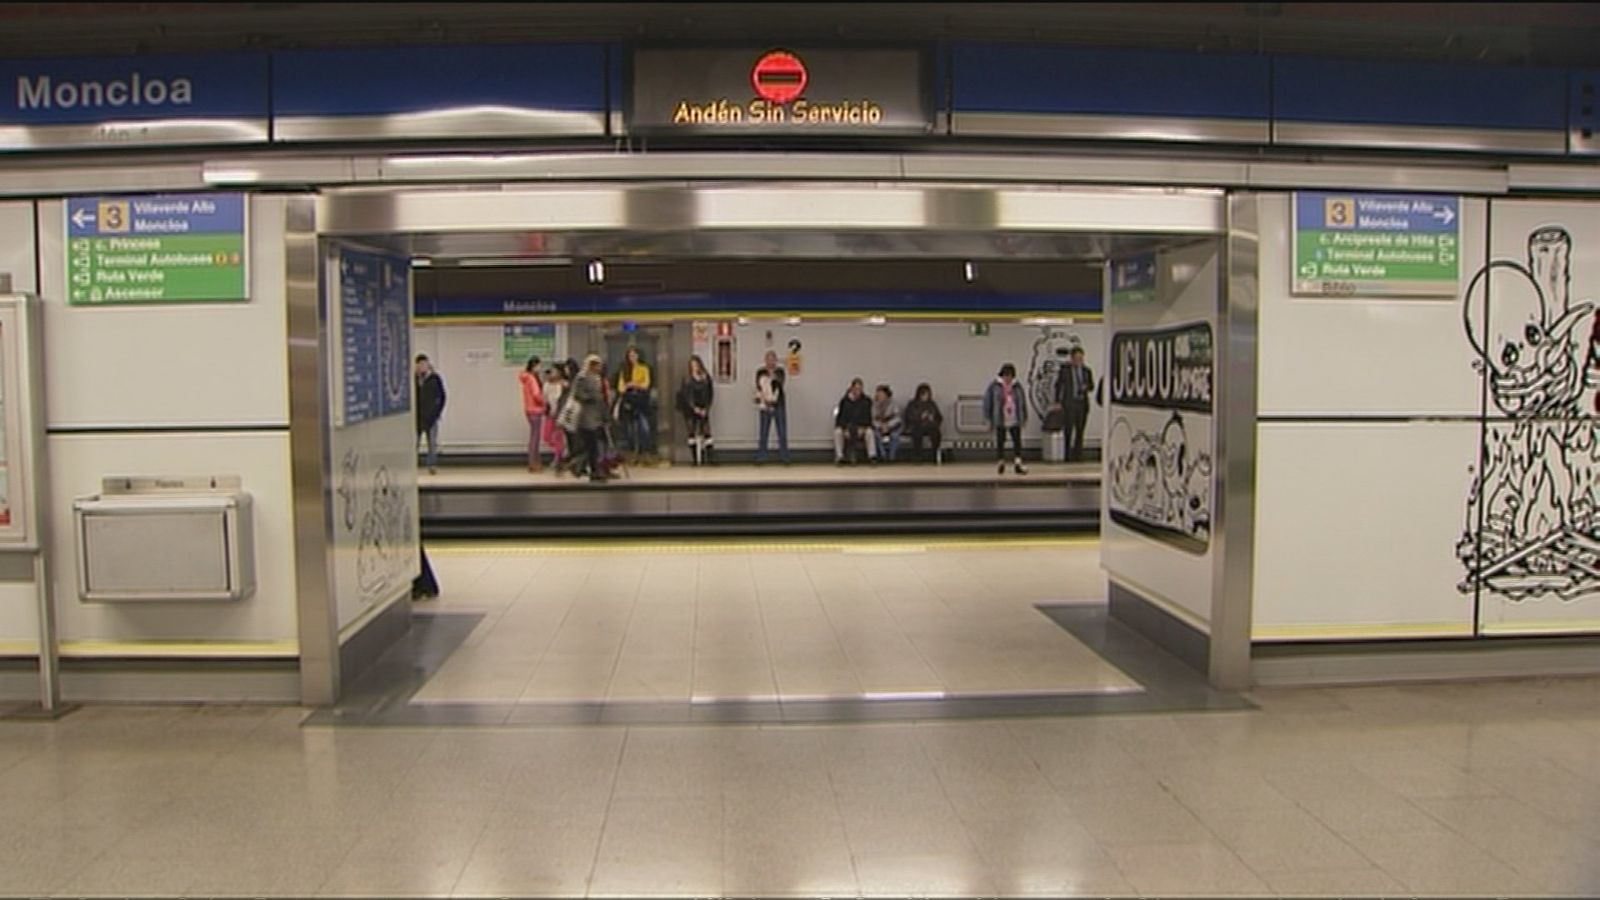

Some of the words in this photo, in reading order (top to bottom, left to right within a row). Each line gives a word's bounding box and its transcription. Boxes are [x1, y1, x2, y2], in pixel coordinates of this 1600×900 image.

[17, 73, 193, 109] Moncloa
[673, 98, 742, 124] Andén
[748, 100, 785, 124] Sin
[791, 101, 881, 124] Servicio
[133, 201, 190, 214] Villaverde
[191, 200, 216, 213] Alto
[1357, 199, 1410, 212] Villaverde
[106, 206, 123, 229] 3
[1331, 202, 1347, 224] 3
[134, 218, 189, 232] Moncloa
[1358, 216, 1409, 229] Moncloa
[110, 238, 161, 251] Princesa
[97, 254, 146, 267] Terminal
[150, 253, 212, 266] Autobuses
[1326, 248, 1375, 260] Terminal
[1376, 250, 1434, 262] Autobuses
[1322, 263, 1350, 275] Ruta
[1352, 264, 1386, 275] Verde
[96, 271, 126, 283] Ruta
[128, 271, 164, 282] Verde
[105, 286, 164, 300] Ascensor
